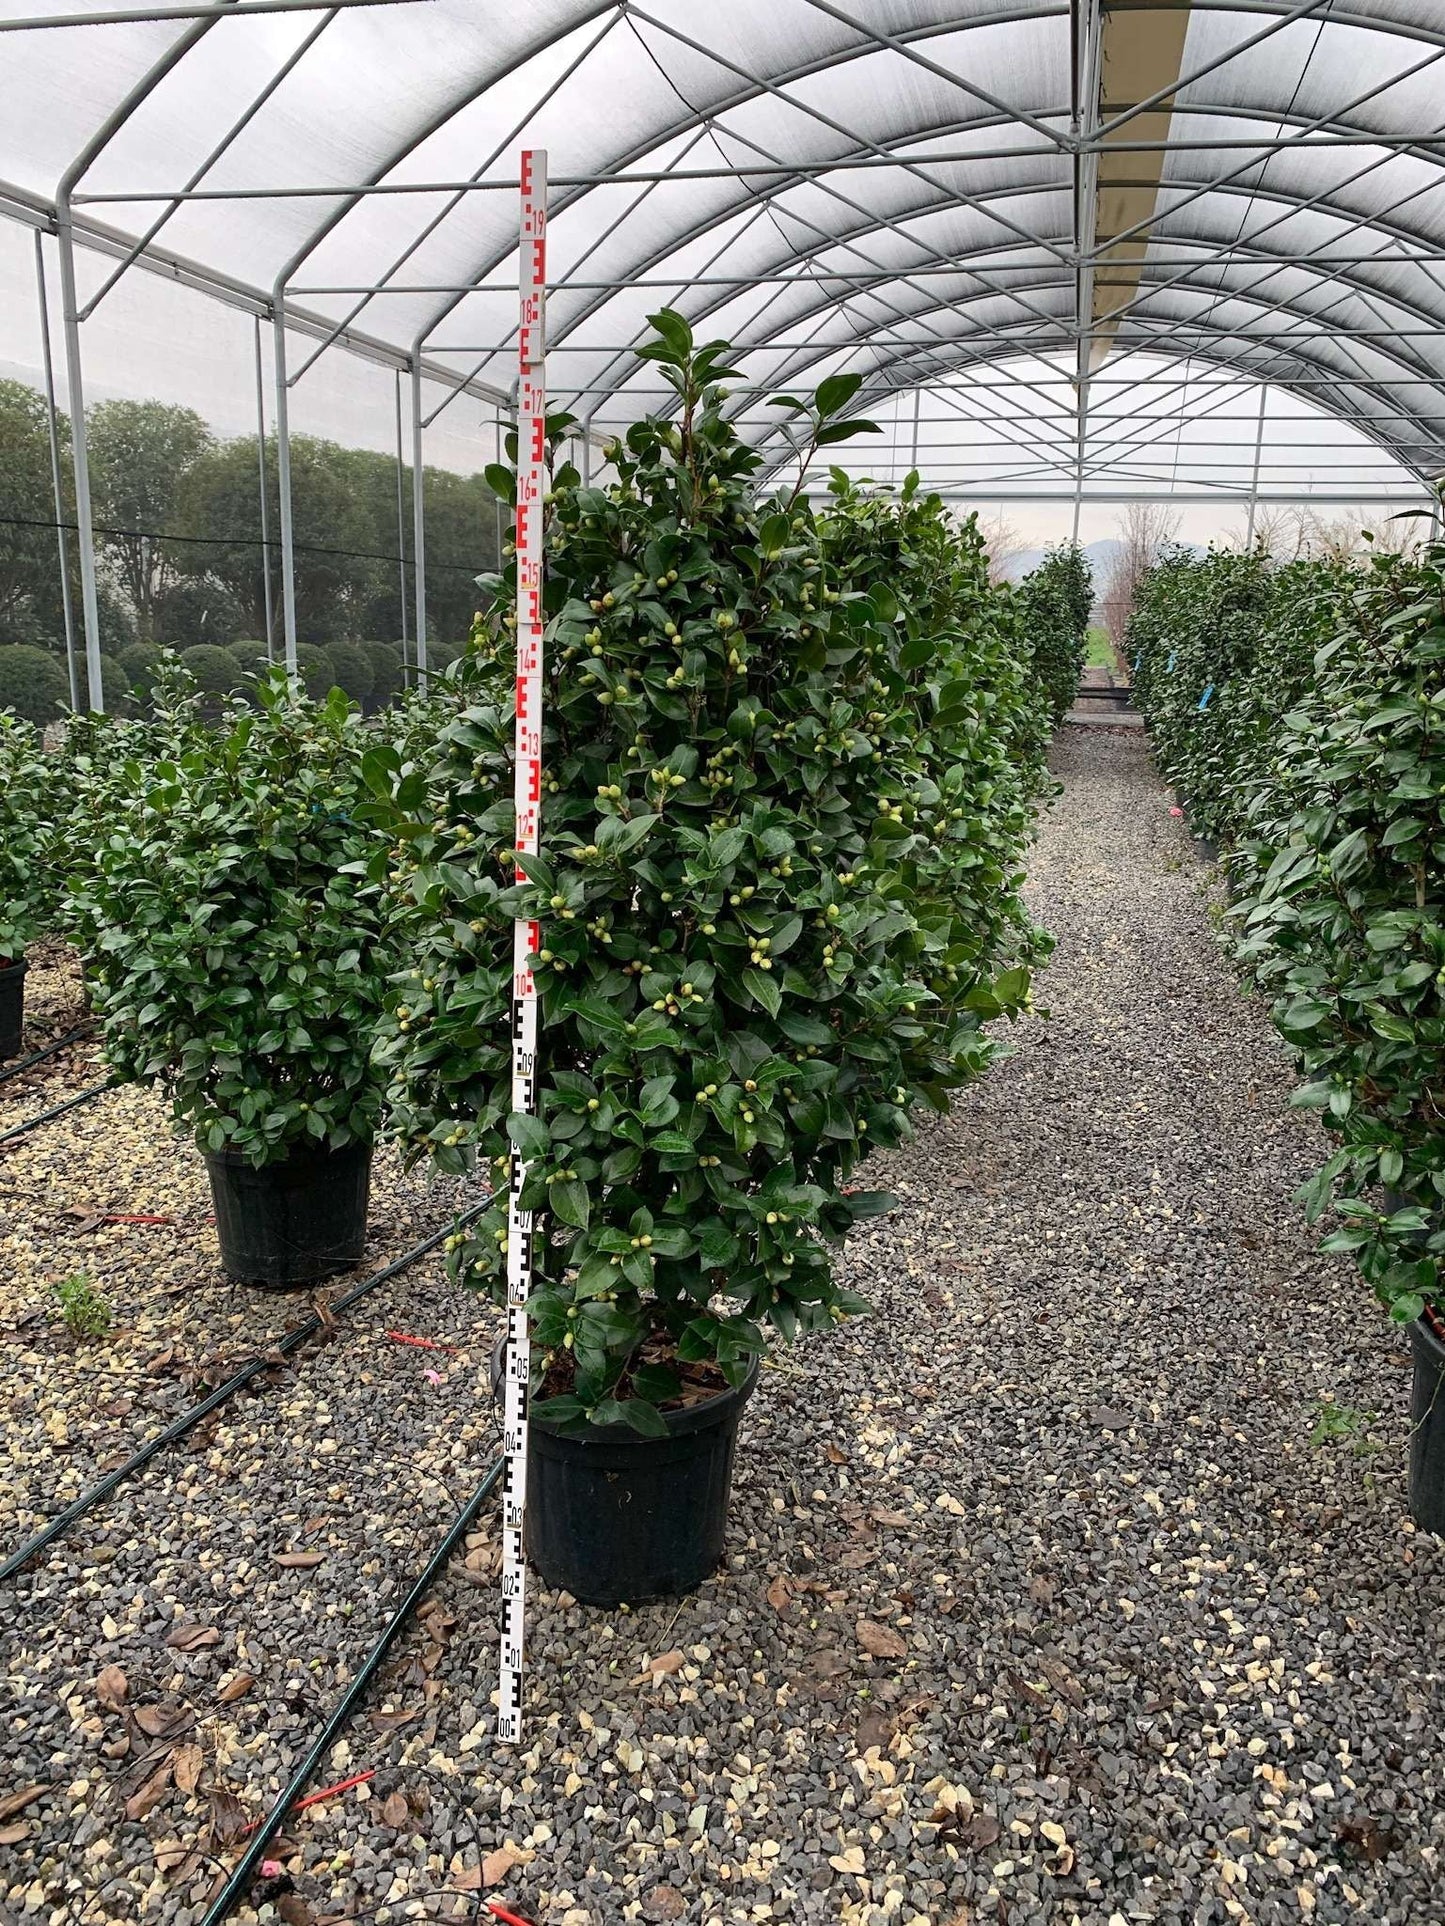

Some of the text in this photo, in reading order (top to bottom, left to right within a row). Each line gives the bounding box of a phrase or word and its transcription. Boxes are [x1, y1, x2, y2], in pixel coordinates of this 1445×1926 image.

[532, 209, 544, 236] 19
[520, 299, 532, 324] 18
[531, 389, 543, 414] 17
[519, 476, 531, 501] 16
[528, 562, 538, 588] 15
[519, 648, 530, 672] 14
[528, 732, 539, 756] 13
[518, 814, 529, 834] 12
[515, 973, 527, 997] 10
[522, 1052, 533, 1076] 09
[509, 1283, 520, 1305] 06
[516, 1357, 528, 1380] 05
[505, 1431, 516, 1454] 04
[511, 1506, 523, 1529] 03
[503, 1574, 514, 1596] 02
[510, 1647, 520, 1669] 01
[499, 1717, 511, 1739] 00
